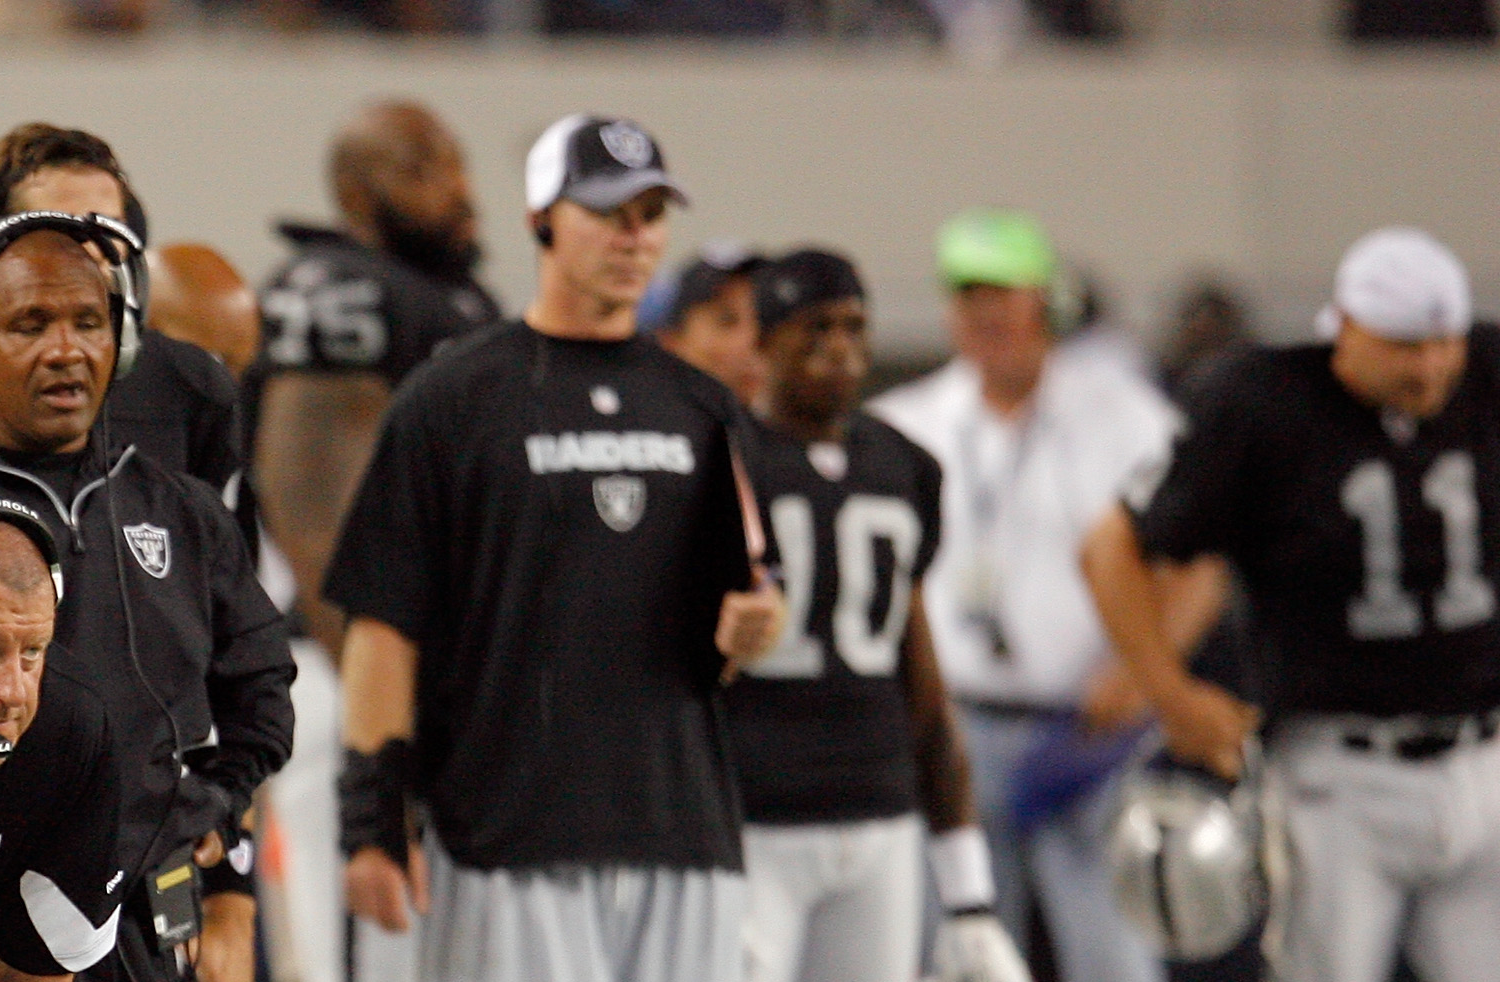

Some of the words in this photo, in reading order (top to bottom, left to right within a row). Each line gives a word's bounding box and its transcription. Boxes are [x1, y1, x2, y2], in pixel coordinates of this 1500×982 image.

[524, 430, 696, 475] RAIDERS
[738, 493, 923, 679] 10
[1339, 451, 1495, 641] 11
